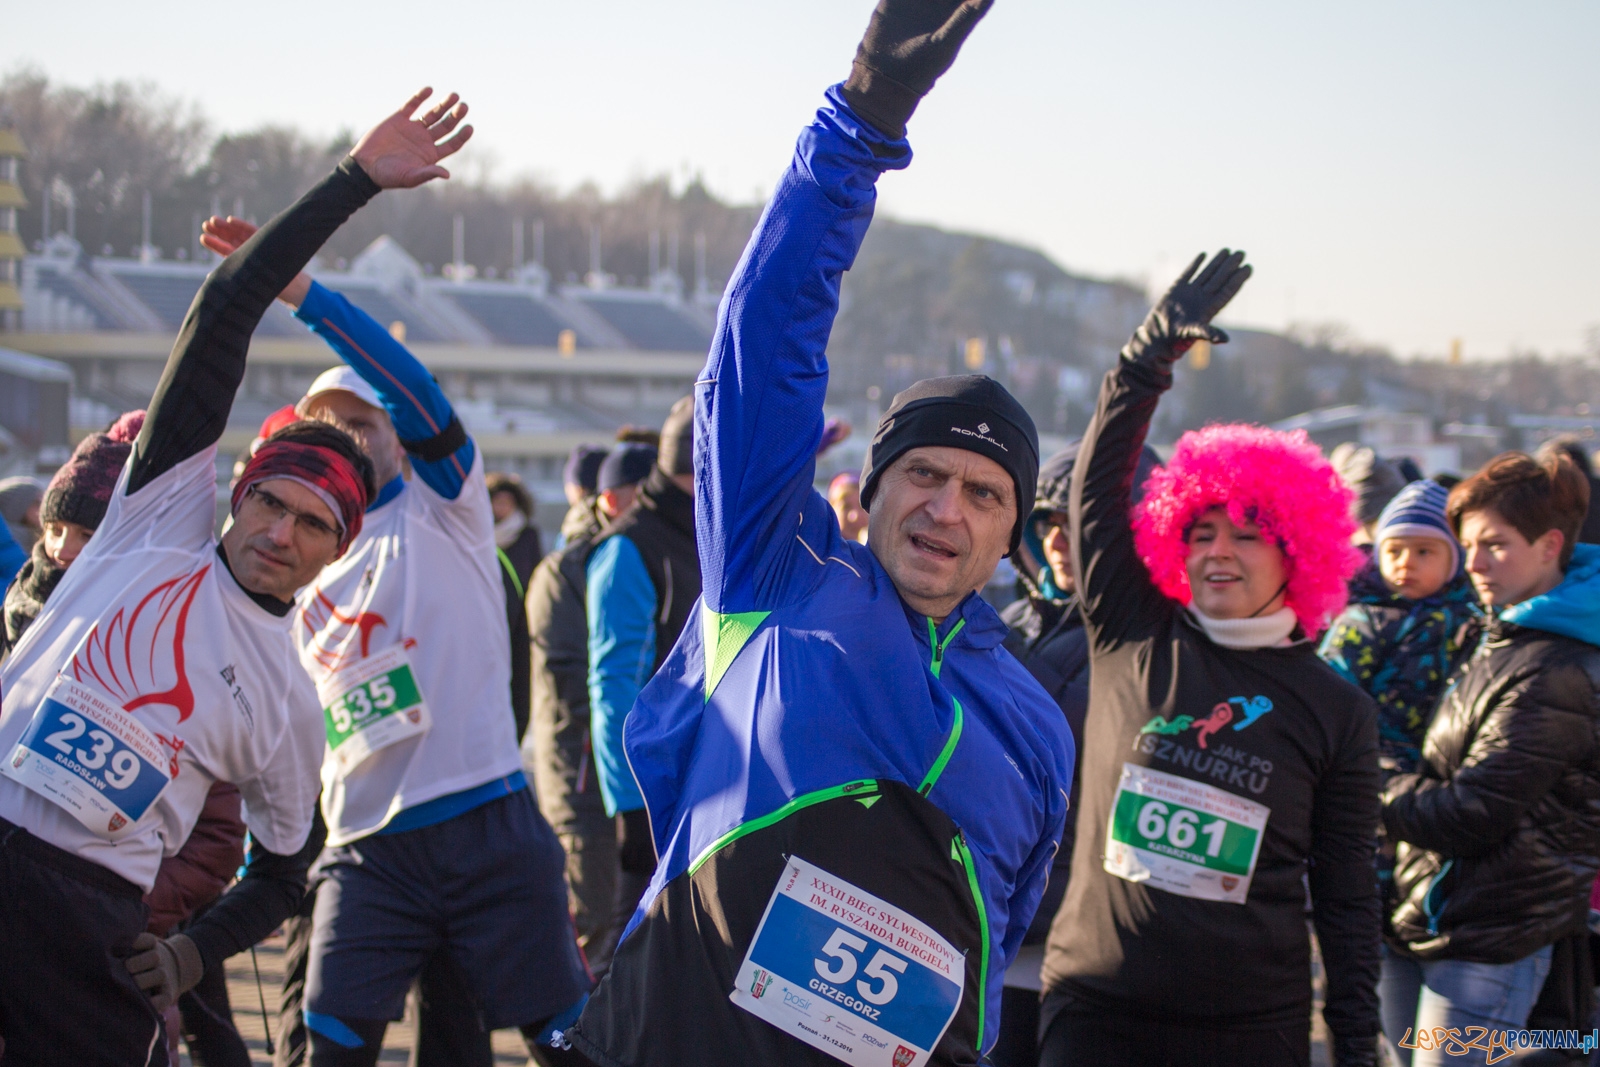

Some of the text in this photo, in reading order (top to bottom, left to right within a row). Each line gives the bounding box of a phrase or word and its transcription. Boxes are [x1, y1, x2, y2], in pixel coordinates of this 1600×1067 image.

[950, 426, 1009, 452] RONHILL
[78, 703, 123, 737] RYSZARDA
[329, 674, 397, 734] 535
[44, 712, 141, 791] 239
[54, 752, 107, 791] RADOSŁAW
[1140, 733, 1269, 795] SZNURKU
[1210, 743, 1273, 775] JAK PO
[1137, 800, 1228, 859] 661
[809, 877, 847, 902] XXXII
[846, 895, 877, 917] BIEG
[809, 893, 951, 974] IM. RYSZARDA BURGIELA
[813, 927, 909, 1006] 55
[808, 978, 882, 1021] GRZEGORZ
[821, 1034, 854, 1054] 31.12.2016
